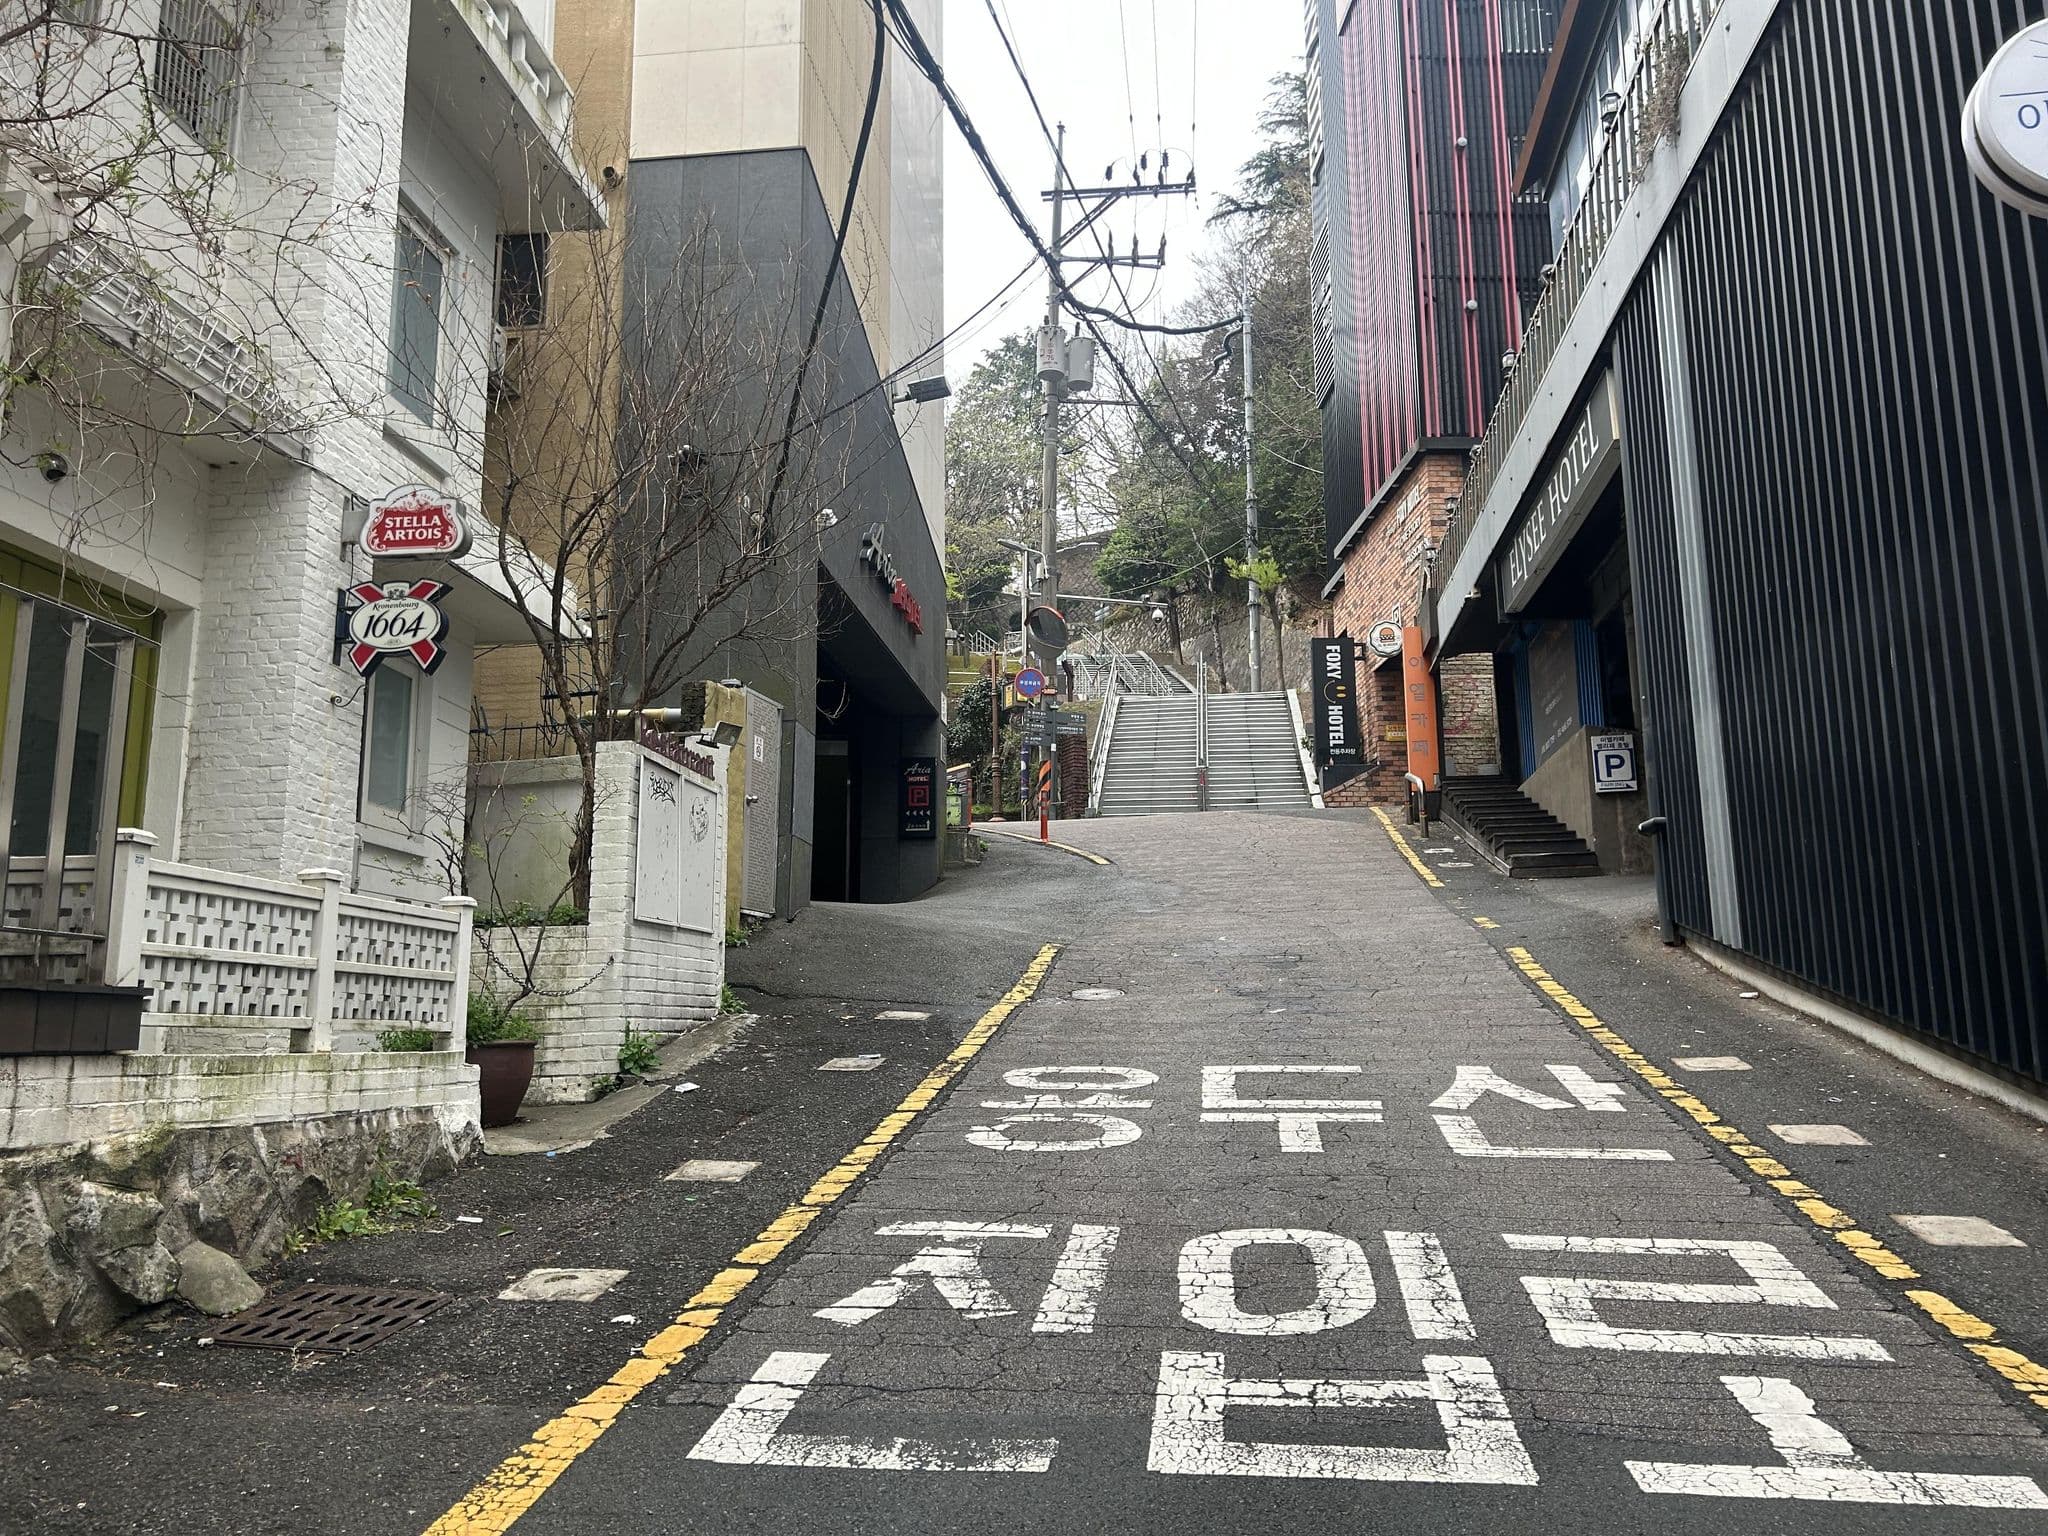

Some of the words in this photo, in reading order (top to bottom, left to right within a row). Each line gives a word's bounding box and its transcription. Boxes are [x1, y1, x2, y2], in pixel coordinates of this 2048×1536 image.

[1508, 502, 1547, 588] ELYSEE
[1547, 403, 1600, 525] HOTEL
[383, 527, 442, 541] ARTOIS
[384, 515, 442, 529] STELLA
[372, 601, 420, 612] Kronenbourg
[363, 609, 427, 639] 1664
[1326, 645, 1342, 679] FOXY
[1328, 705, 1344, 747] HOTEL
[904, 762, 931, 775] Aria
[1606, 755, 1625, 777] P
[964, 1063, 1675, 1163] 용두산
[686, 1220, 2048, 1511] 진입로
